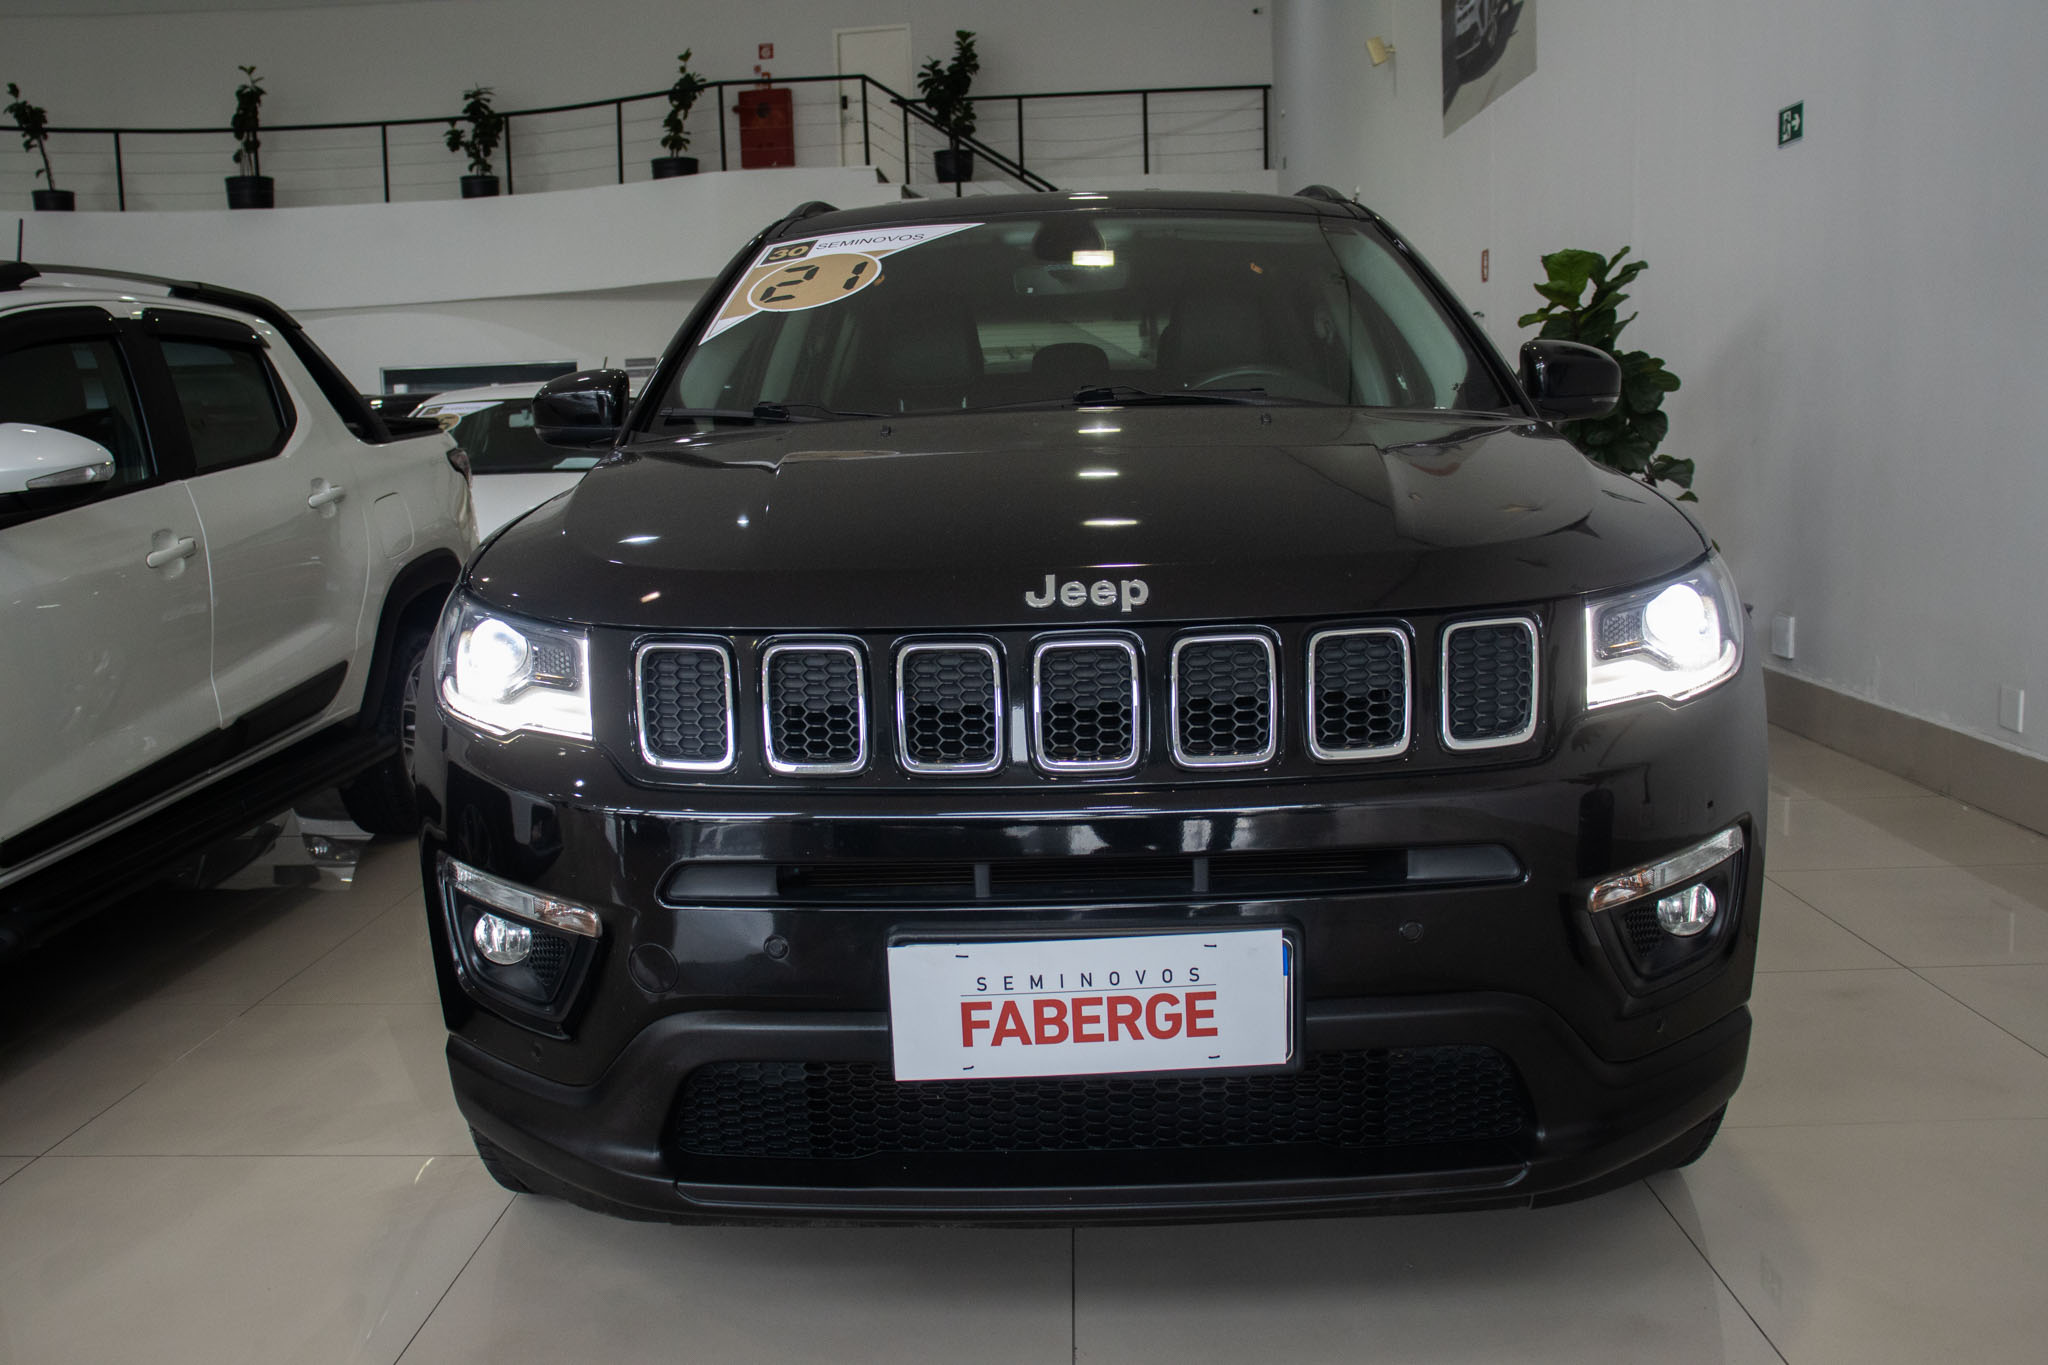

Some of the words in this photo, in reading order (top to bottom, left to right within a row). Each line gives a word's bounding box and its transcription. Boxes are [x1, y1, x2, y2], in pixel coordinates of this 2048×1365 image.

[768, 245, 809, 260] 30
[816, 233, 925, 249] SEMINOVOS
[760, 261, 869, 303] 21
[1025, 574, 1149, 612] Jeep
[976, 967, 1201, 992] SEMINOVOS
[960, 991, 1218, 1048] FABERGE
